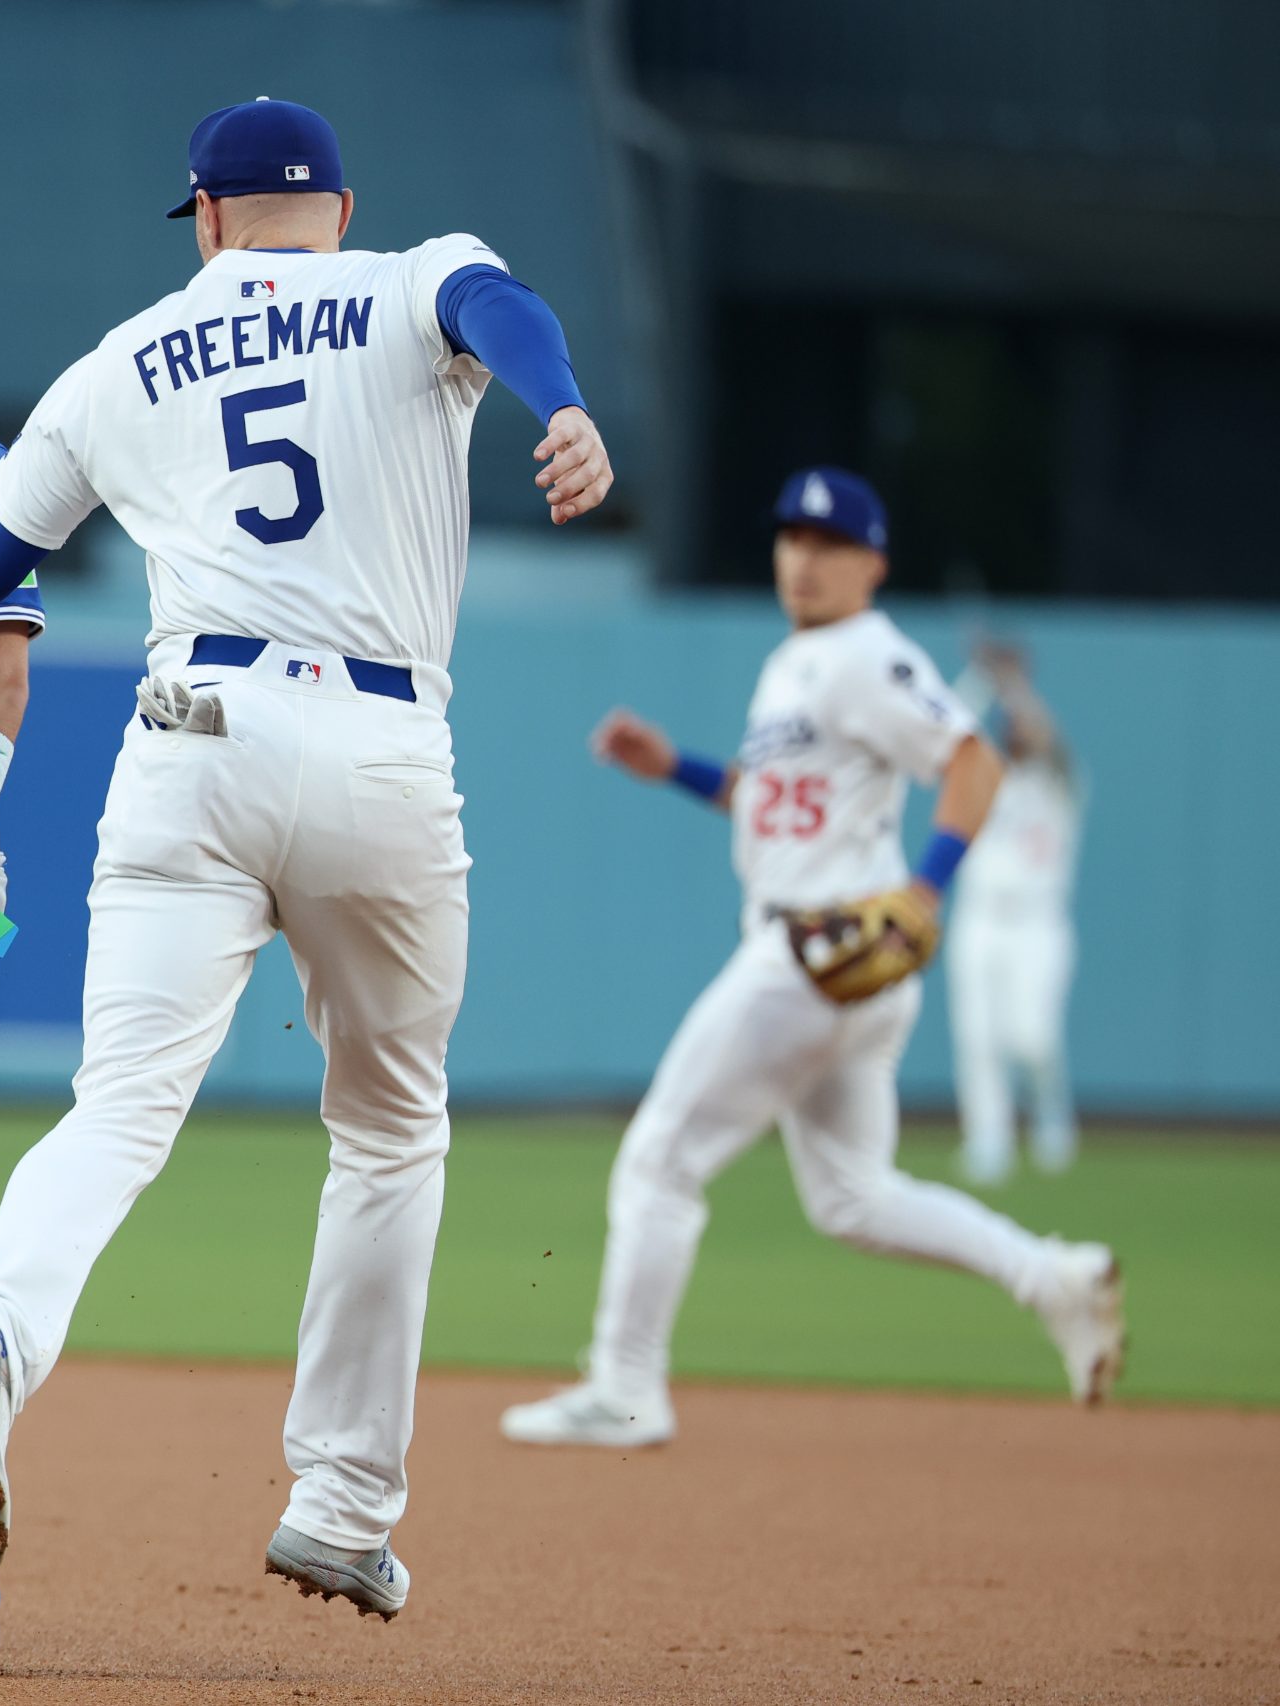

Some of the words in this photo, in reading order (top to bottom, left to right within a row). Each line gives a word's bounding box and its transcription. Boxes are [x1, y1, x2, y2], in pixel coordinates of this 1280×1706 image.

[133, 296, 374, 406] FREEMAN
[220, 379, 325, 545] 5
[751, 770, 831, 841] 25
